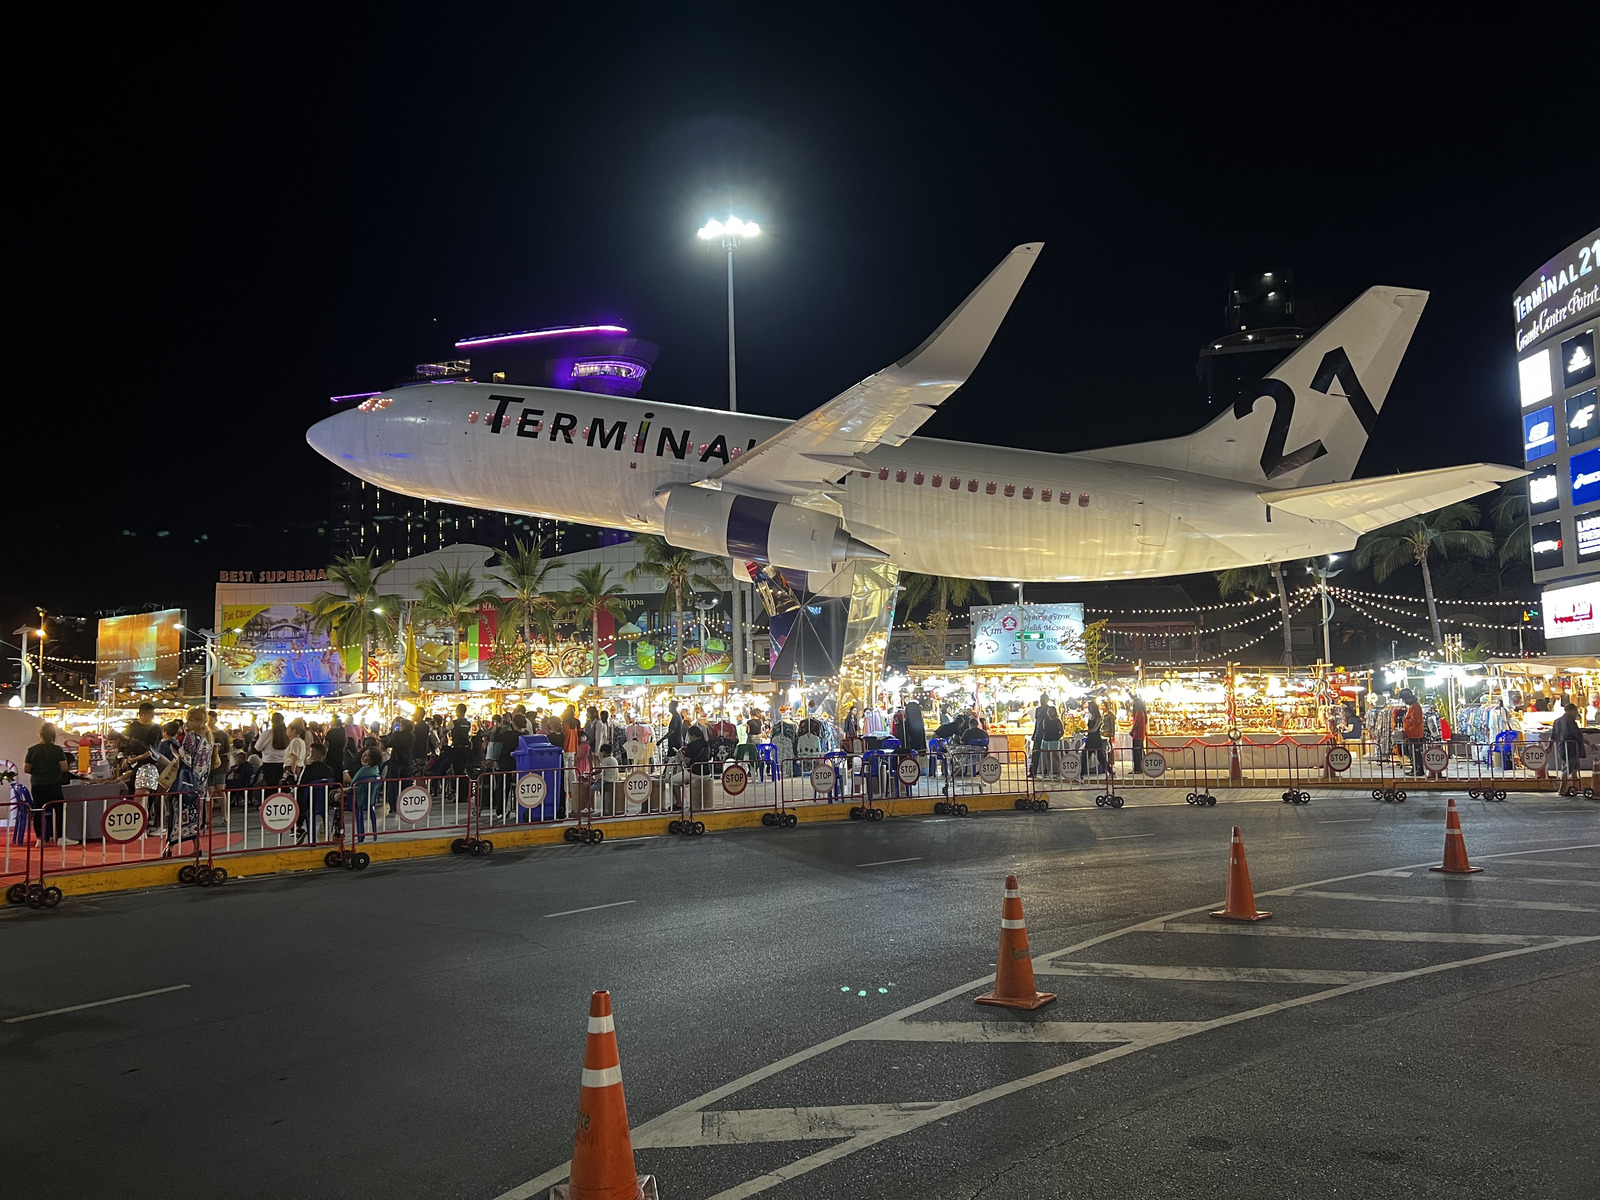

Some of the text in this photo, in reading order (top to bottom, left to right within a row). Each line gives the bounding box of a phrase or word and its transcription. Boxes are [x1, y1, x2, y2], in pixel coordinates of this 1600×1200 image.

[1578, 238, 1600, 277] 21
[1233, 345, 1379, 481] 21
[220, 568, 327, 583] BEST SUPERMA
[981, 626, 1003, 637] Kim
[1330, 754, 1349, 762] STOP
[1426, 754, 1445, 762] STOP
[1526, 752, 1544, 760] STOP
[982, 763, 999, 773] STOP
[1062, 761, 1079, 770] STOP
[1144, 759, 1163, 767] STOP
[901, 765, 917, 774] STOP
[725, 773, 744, 783] STOP
[815, 772, 832, 780] STOP
[520, 784, 542, 794] STOP
[628, 780, 648, 791] STOP
[402, 795, 426, 806] STOP
[265, 803, 294, 817] STOP
[108, 812, 141, 827] STOP
